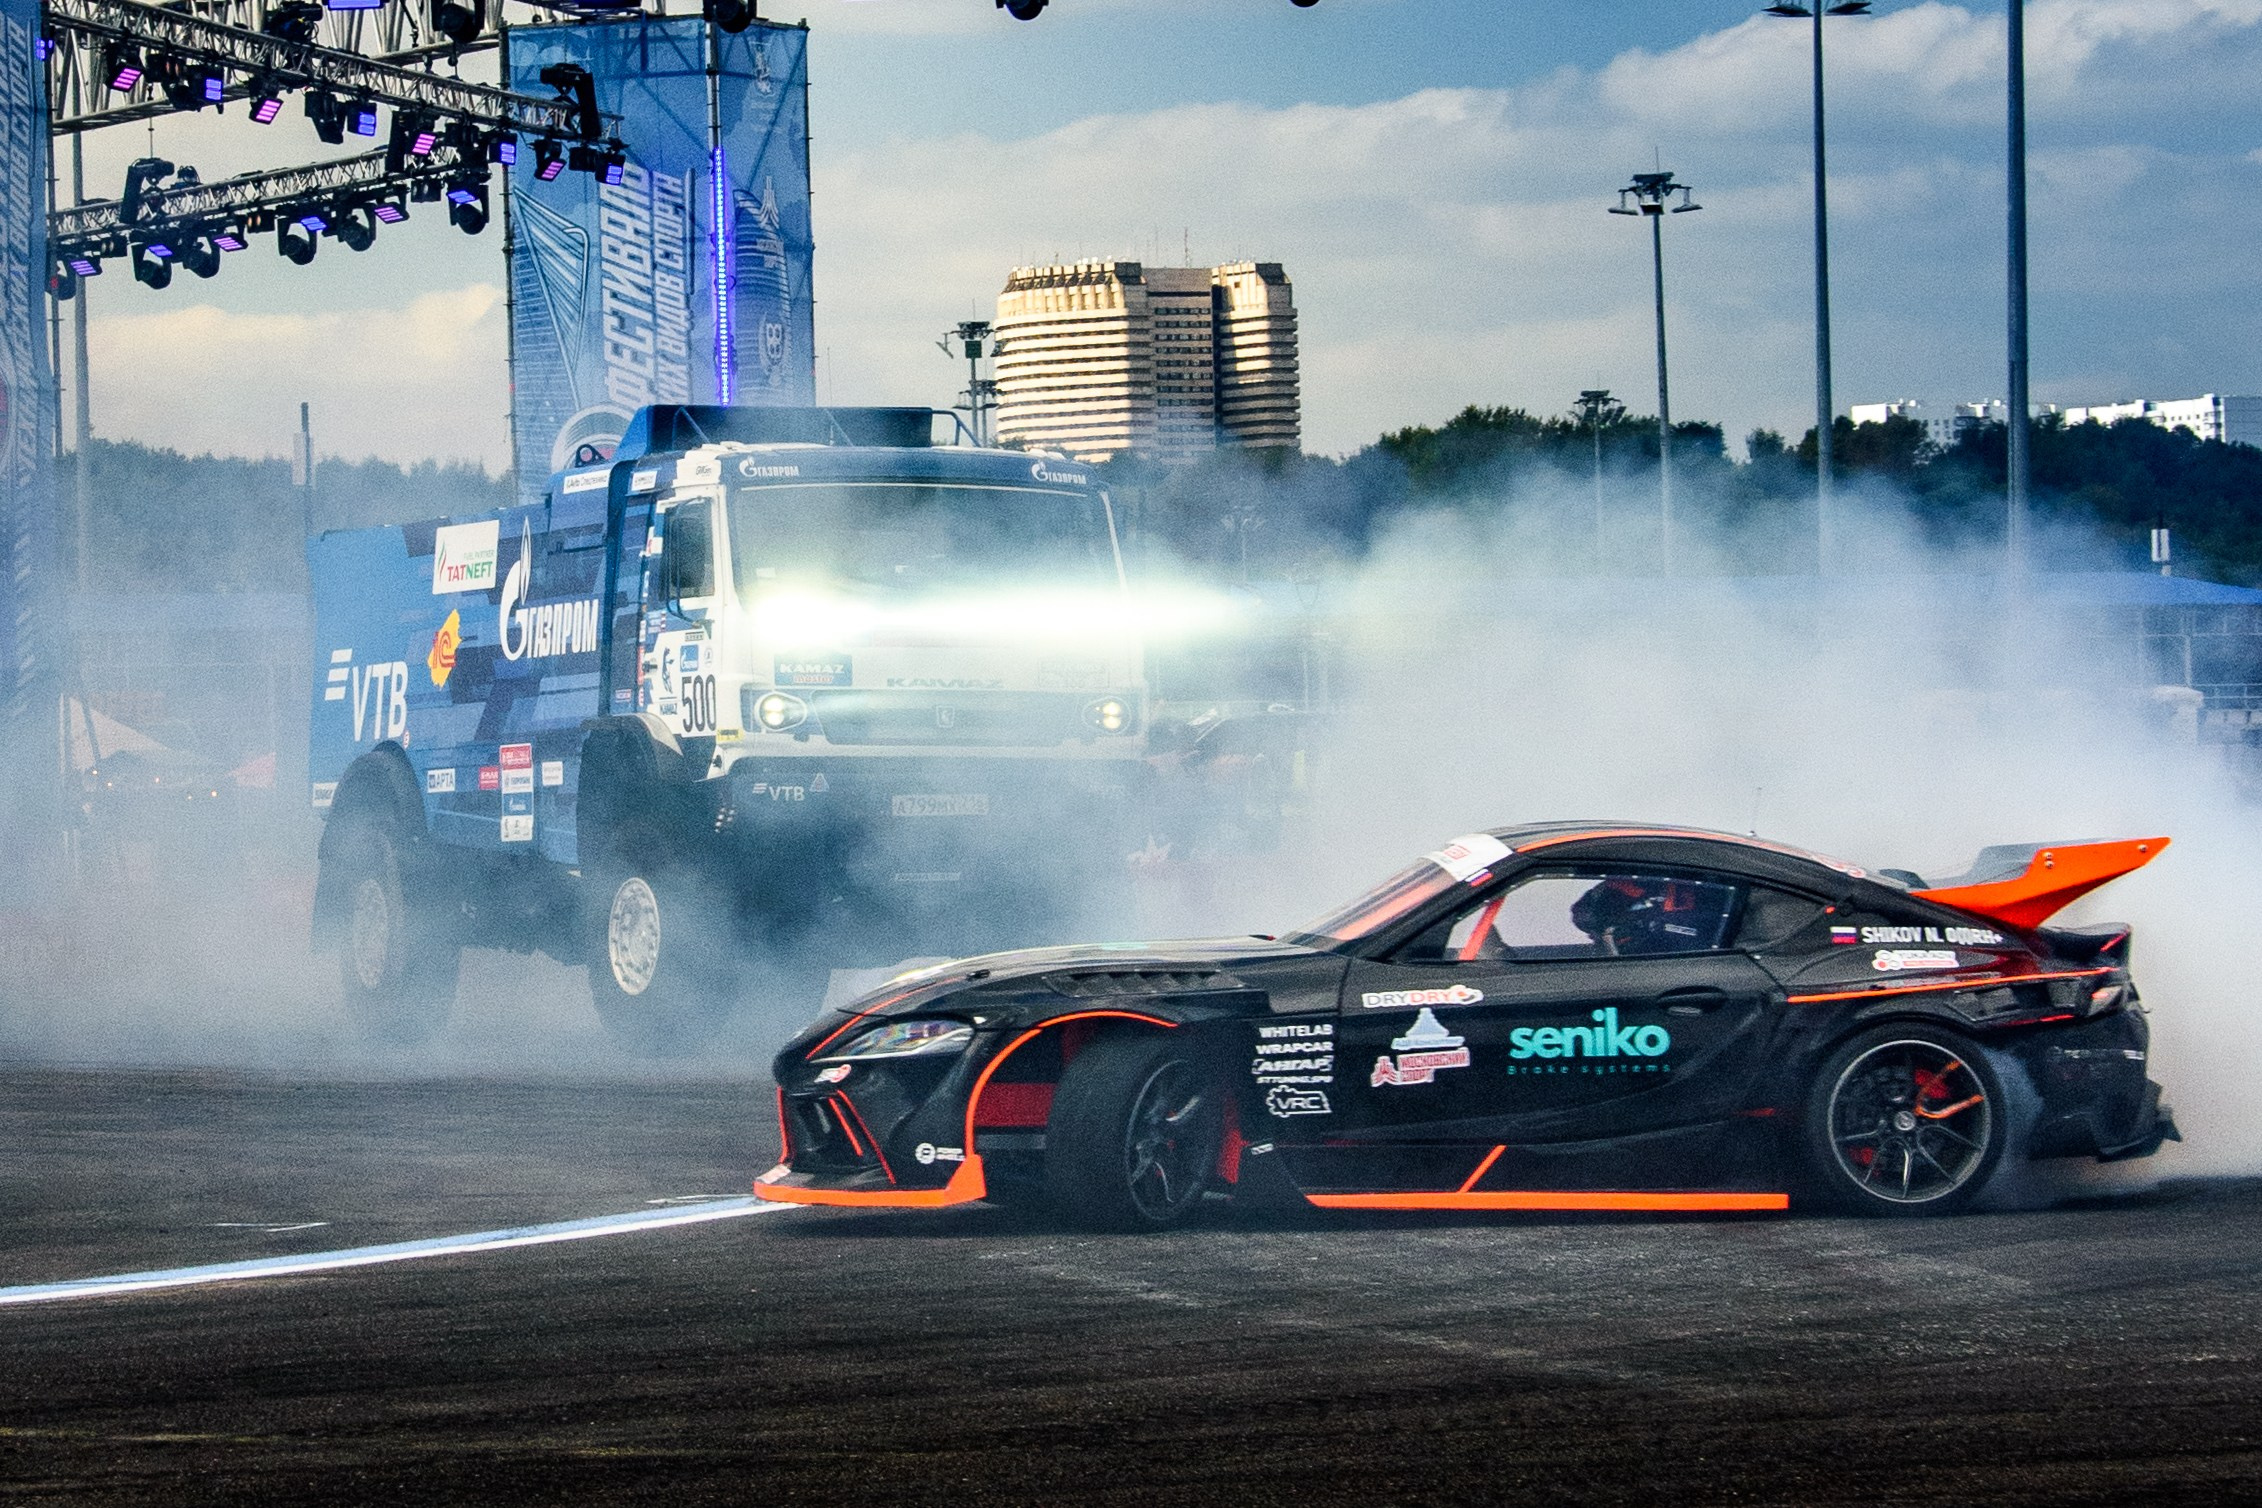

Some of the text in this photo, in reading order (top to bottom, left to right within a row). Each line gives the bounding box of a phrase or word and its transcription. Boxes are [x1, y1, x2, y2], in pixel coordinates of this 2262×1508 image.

[8, 16, 29, 145] СПОРТА
[9, 147, 30, 254] ВИДОВ
[652, 170, 686, 271] СПОРТА
[599, 162, 657, 418] ФЕСТИВАЛЬ
[654, 269, 689, 358] ВИДОВ
[757, 465, 800, 477] ГАЗПРОМ
[1047, 470, 1087, 485] ГАЗПРОМ
[447, 560, 493, 582] TATNEFT
[526, 599, 599, 659] ГАЗПРОМ
[779, 663, 845, 674] KAMAZ
[886, 678, 1004, 688] KAMAZ
[352, 661, 408, 742] VTB
[682, 674, 716, 733] 500
[768, 785, 805, 802] VTB
[1861, 926, 1922, 943] SHIKOV
[1509, 1007, 1671, 1059] seniko
[1255, 1041, 1335, 1055] WRAPCAR
[1507, 1064, 1671, 1076] Brake systems
[1276, 1097, 1321, 1110] VRC
